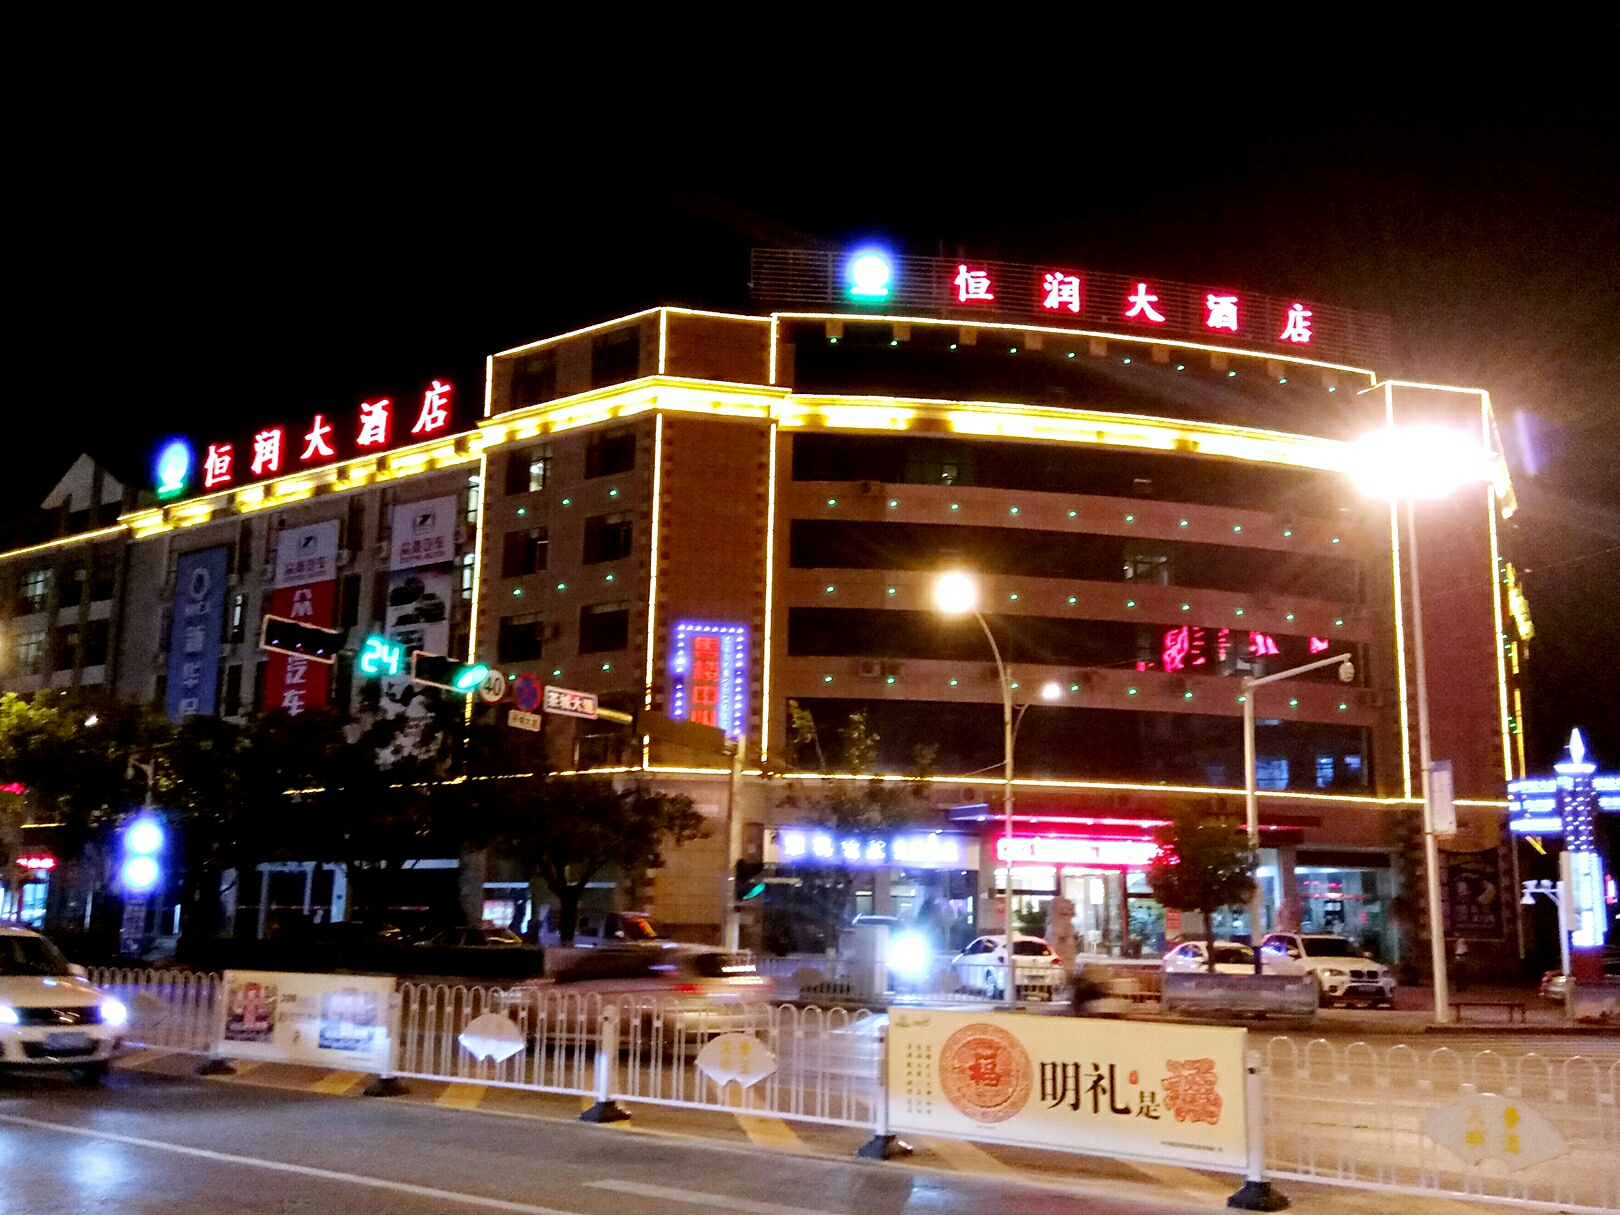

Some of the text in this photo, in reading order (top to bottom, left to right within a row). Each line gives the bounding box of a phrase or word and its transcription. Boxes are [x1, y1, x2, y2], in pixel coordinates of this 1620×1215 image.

[954, 264, 1313, 345] 恒润大酒店
[203, 379, 452, 489] 恒润大酒店
[281, 589, 313, 717] 众汽车
[360, 636, 403, 677] 24
[483, 677, 503, 697] 40
